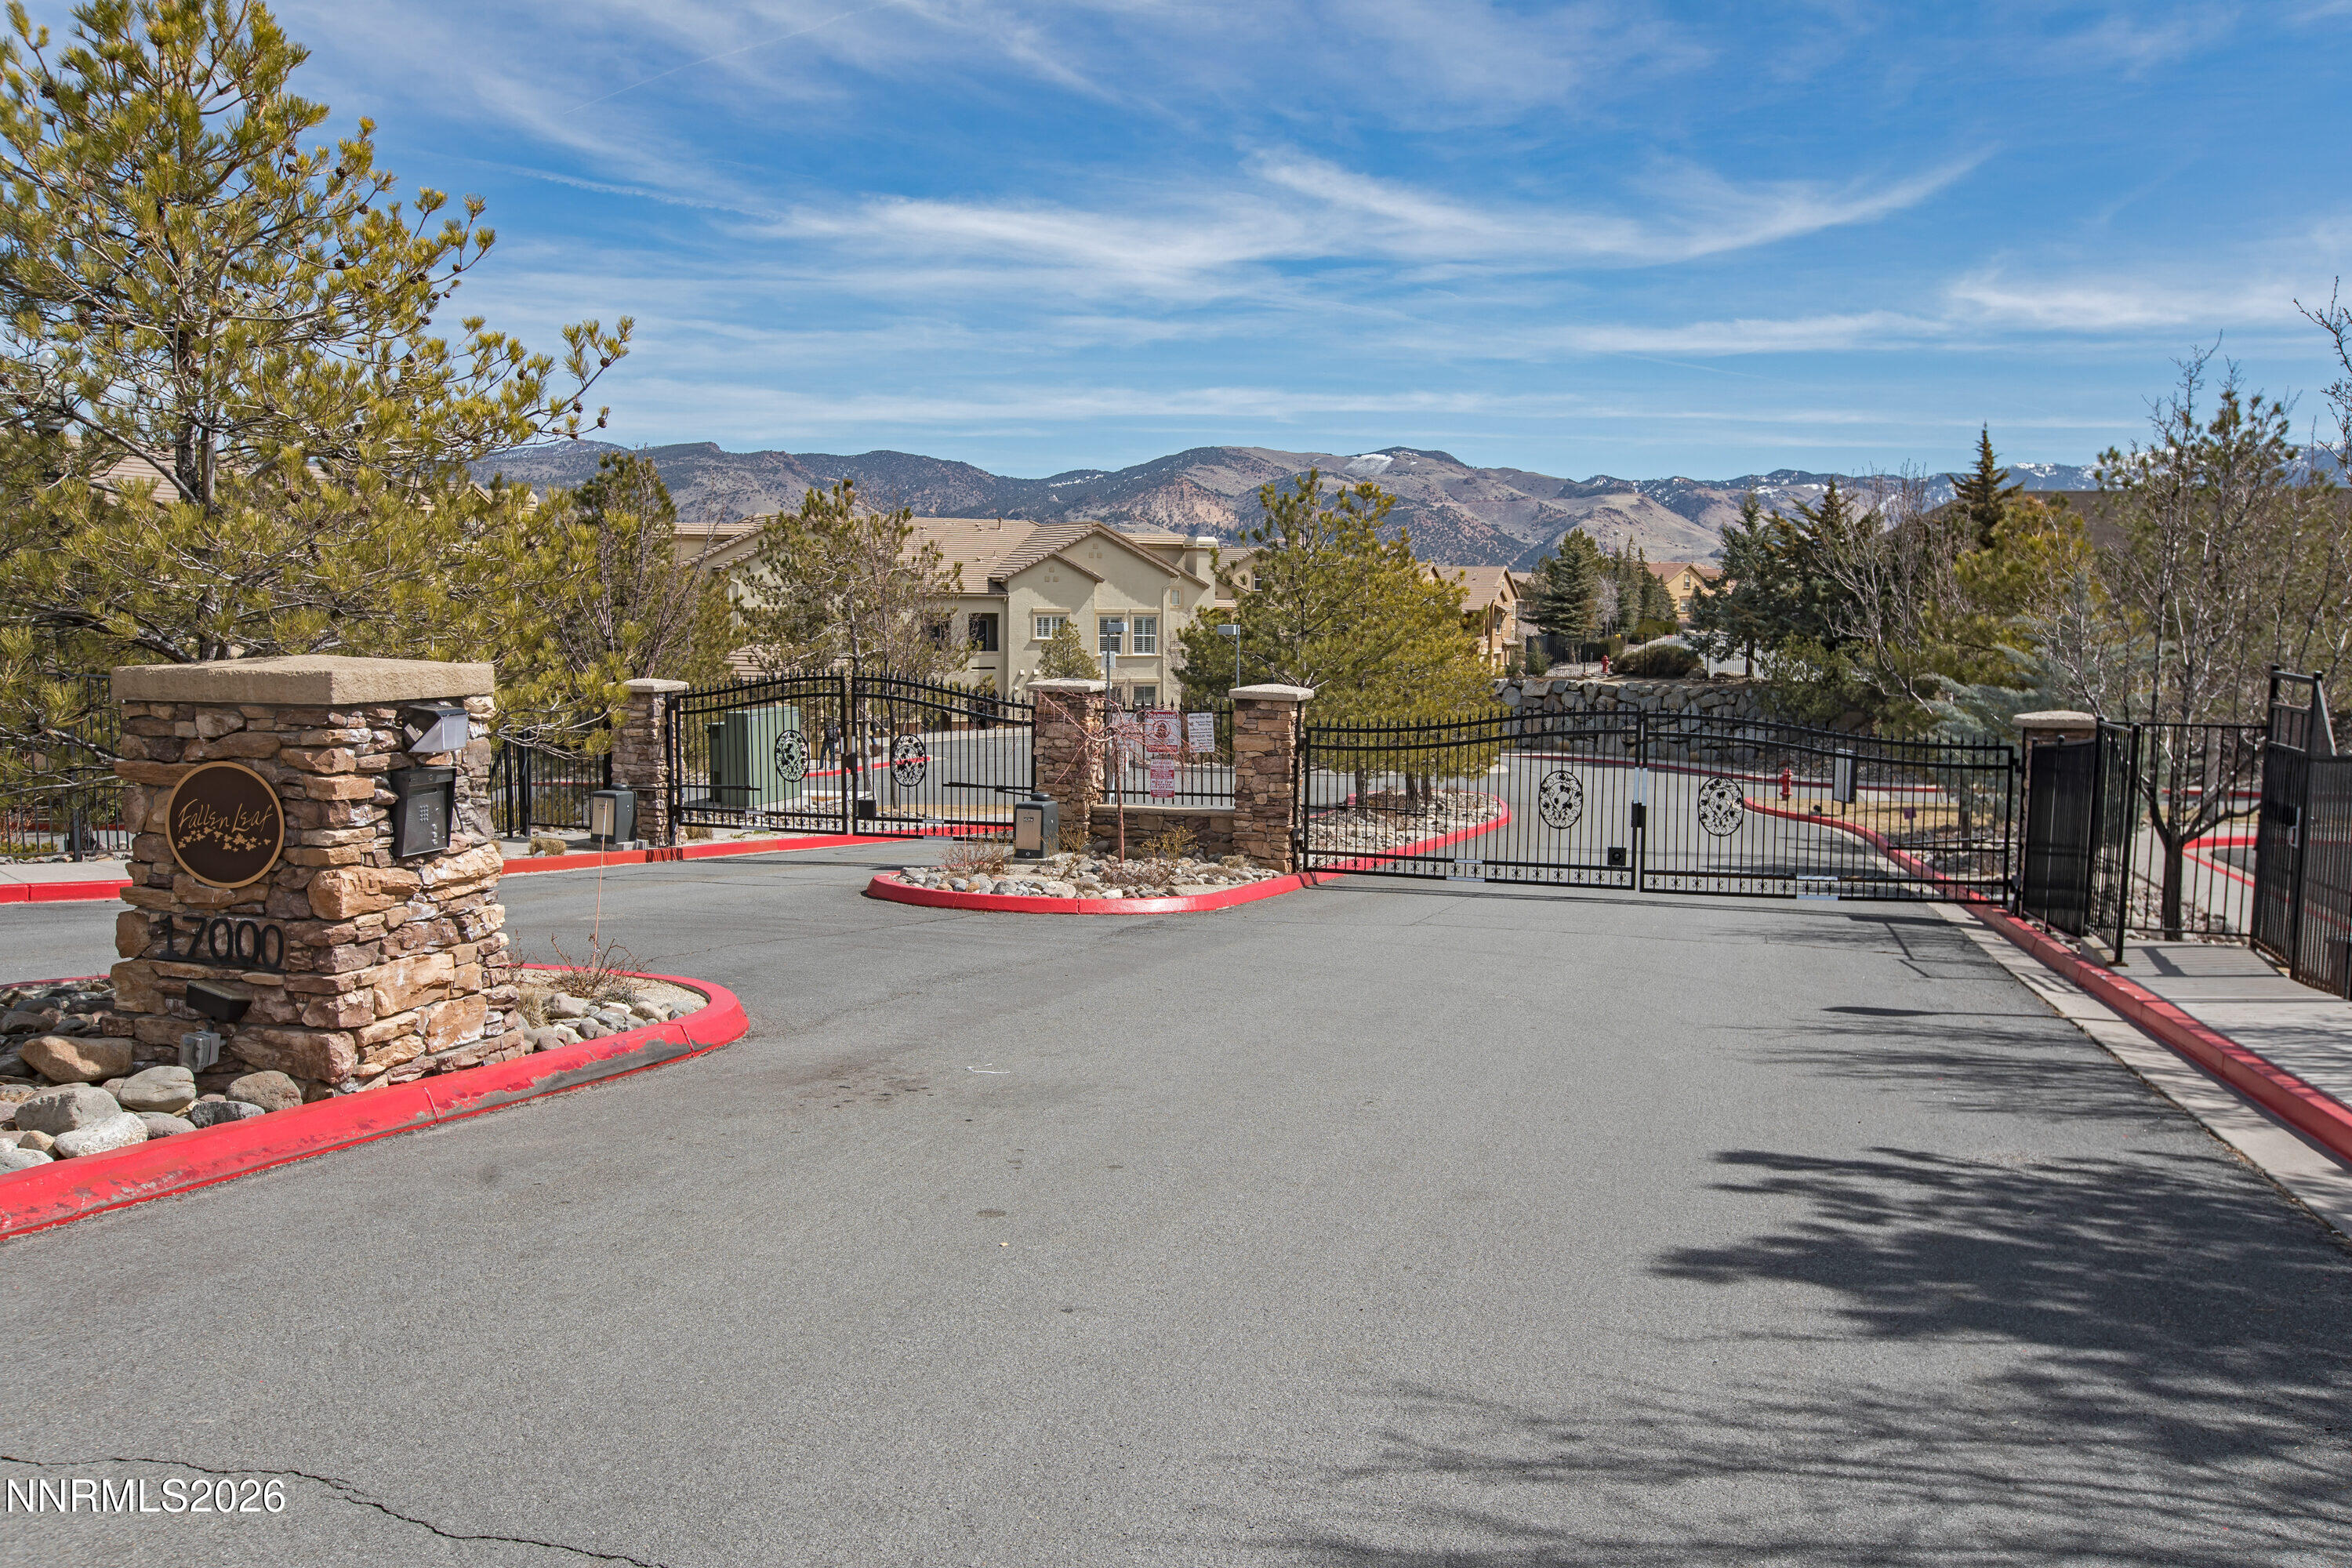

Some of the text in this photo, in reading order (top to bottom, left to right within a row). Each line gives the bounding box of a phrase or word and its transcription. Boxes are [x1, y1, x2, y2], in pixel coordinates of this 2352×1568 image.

[178, 798, 274, 833] Fallen Leaf
[159, 915, 284, 967] 17000
